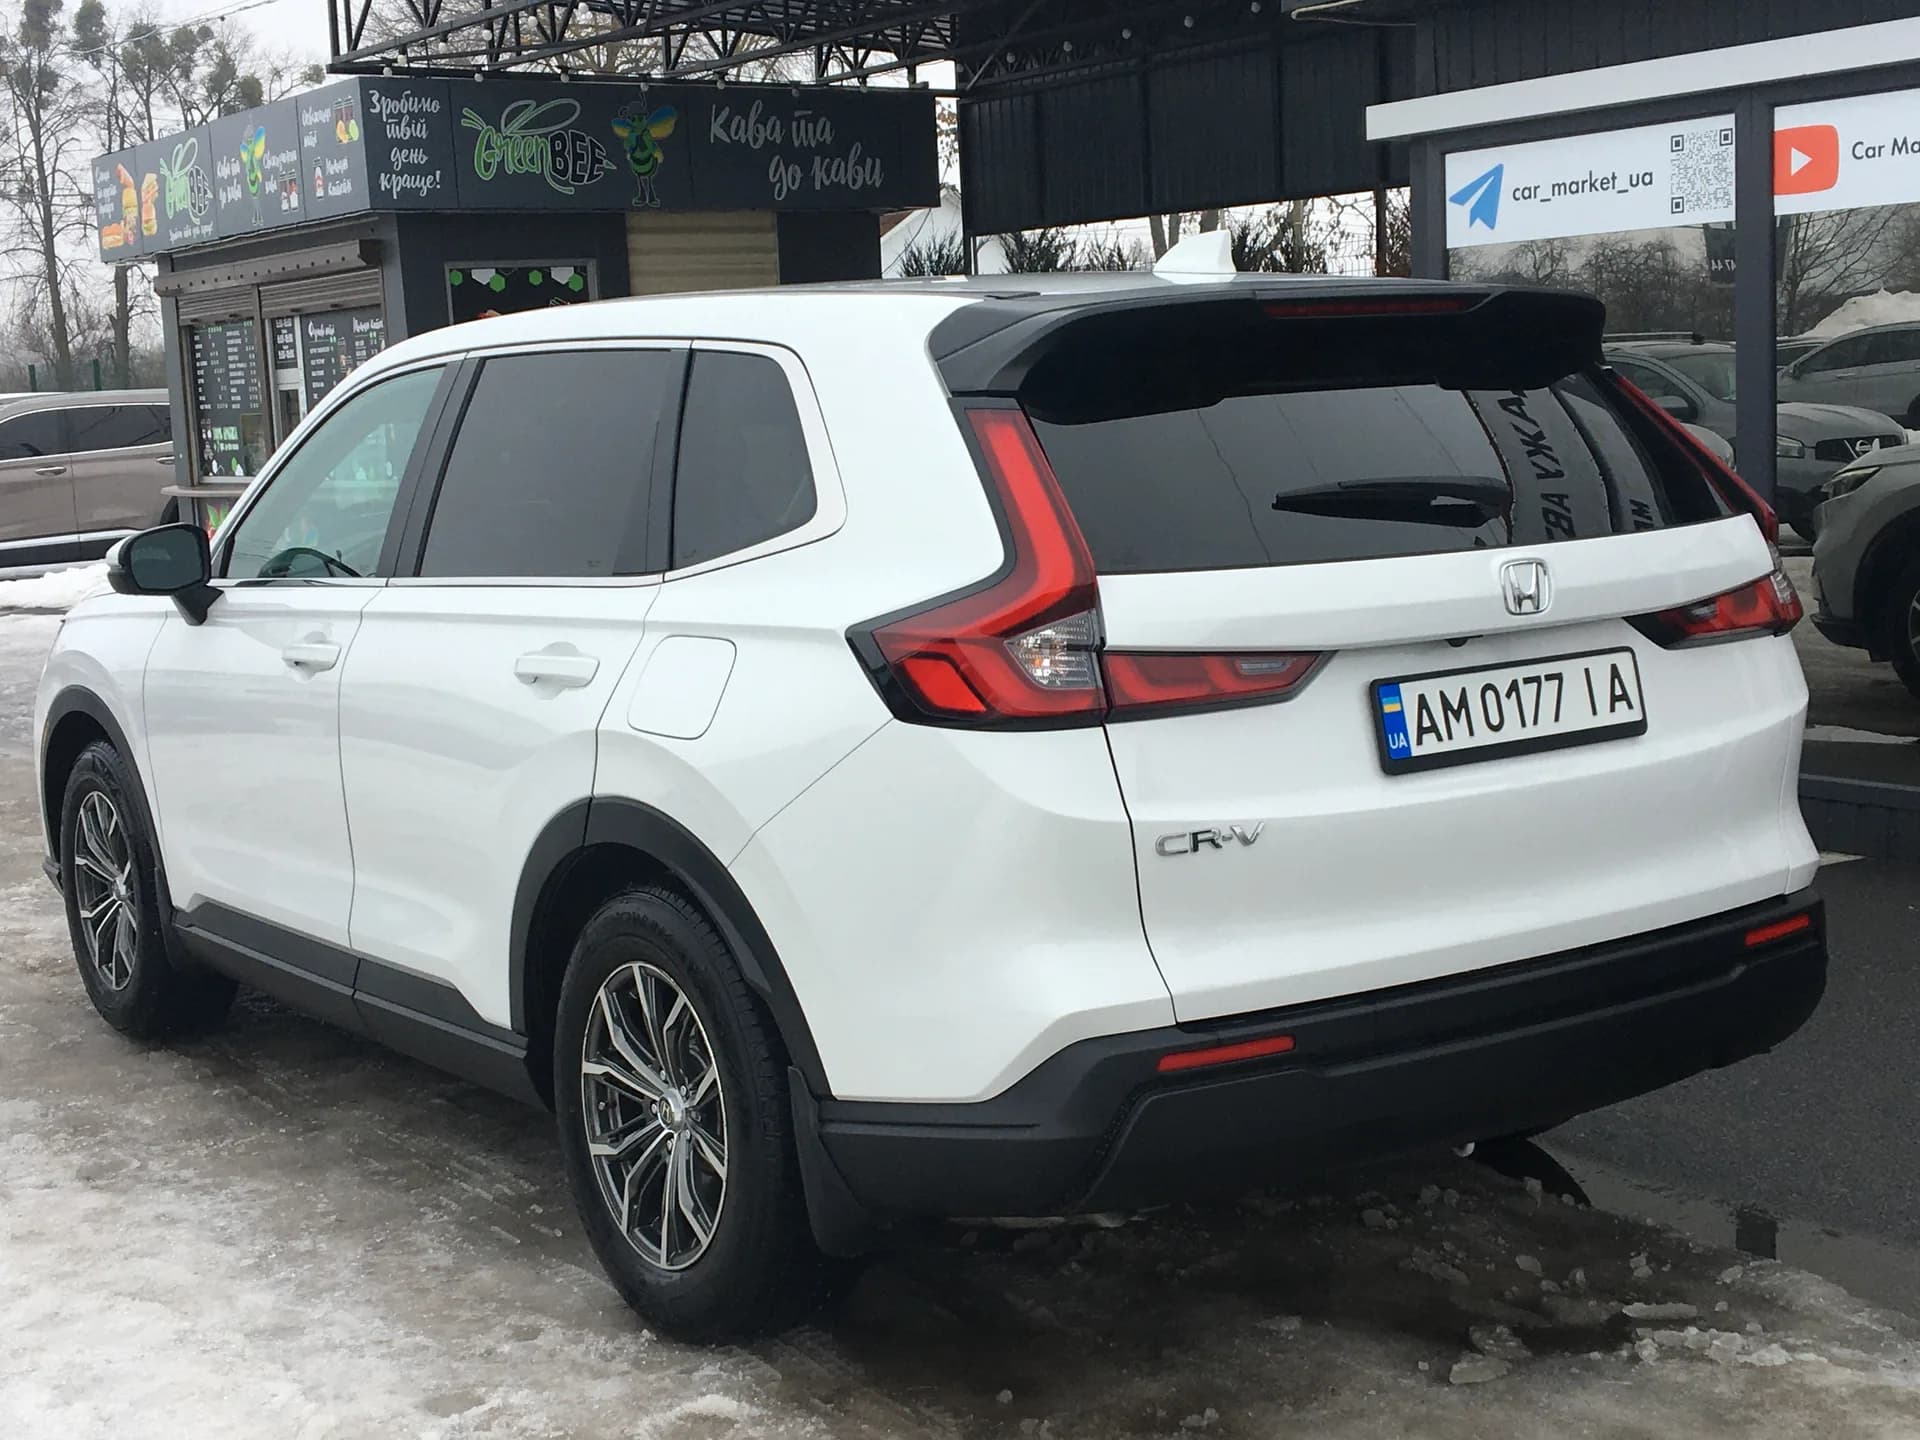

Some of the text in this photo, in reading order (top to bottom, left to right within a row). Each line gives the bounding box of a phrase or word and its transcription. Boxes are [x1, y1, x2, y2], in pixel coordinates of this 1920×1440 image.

[369, 90, 440, 121] Зробимо
[386, 115, 429, 140] твій
[710, 100, 836, 149] Кава та
[390, 147, 429, 171] день
[1852, 141, 1886, 160] Car
[379, 170, 441, 199] краще!
[769, 142, 884, 201] до кави
[1512, 170, 1654, 203] car_market_ua
[1584, 663, 1634, 717] IA
[1389, 733, 1408, 750] UA
[1155, 820, 1265, 856] CR-V
